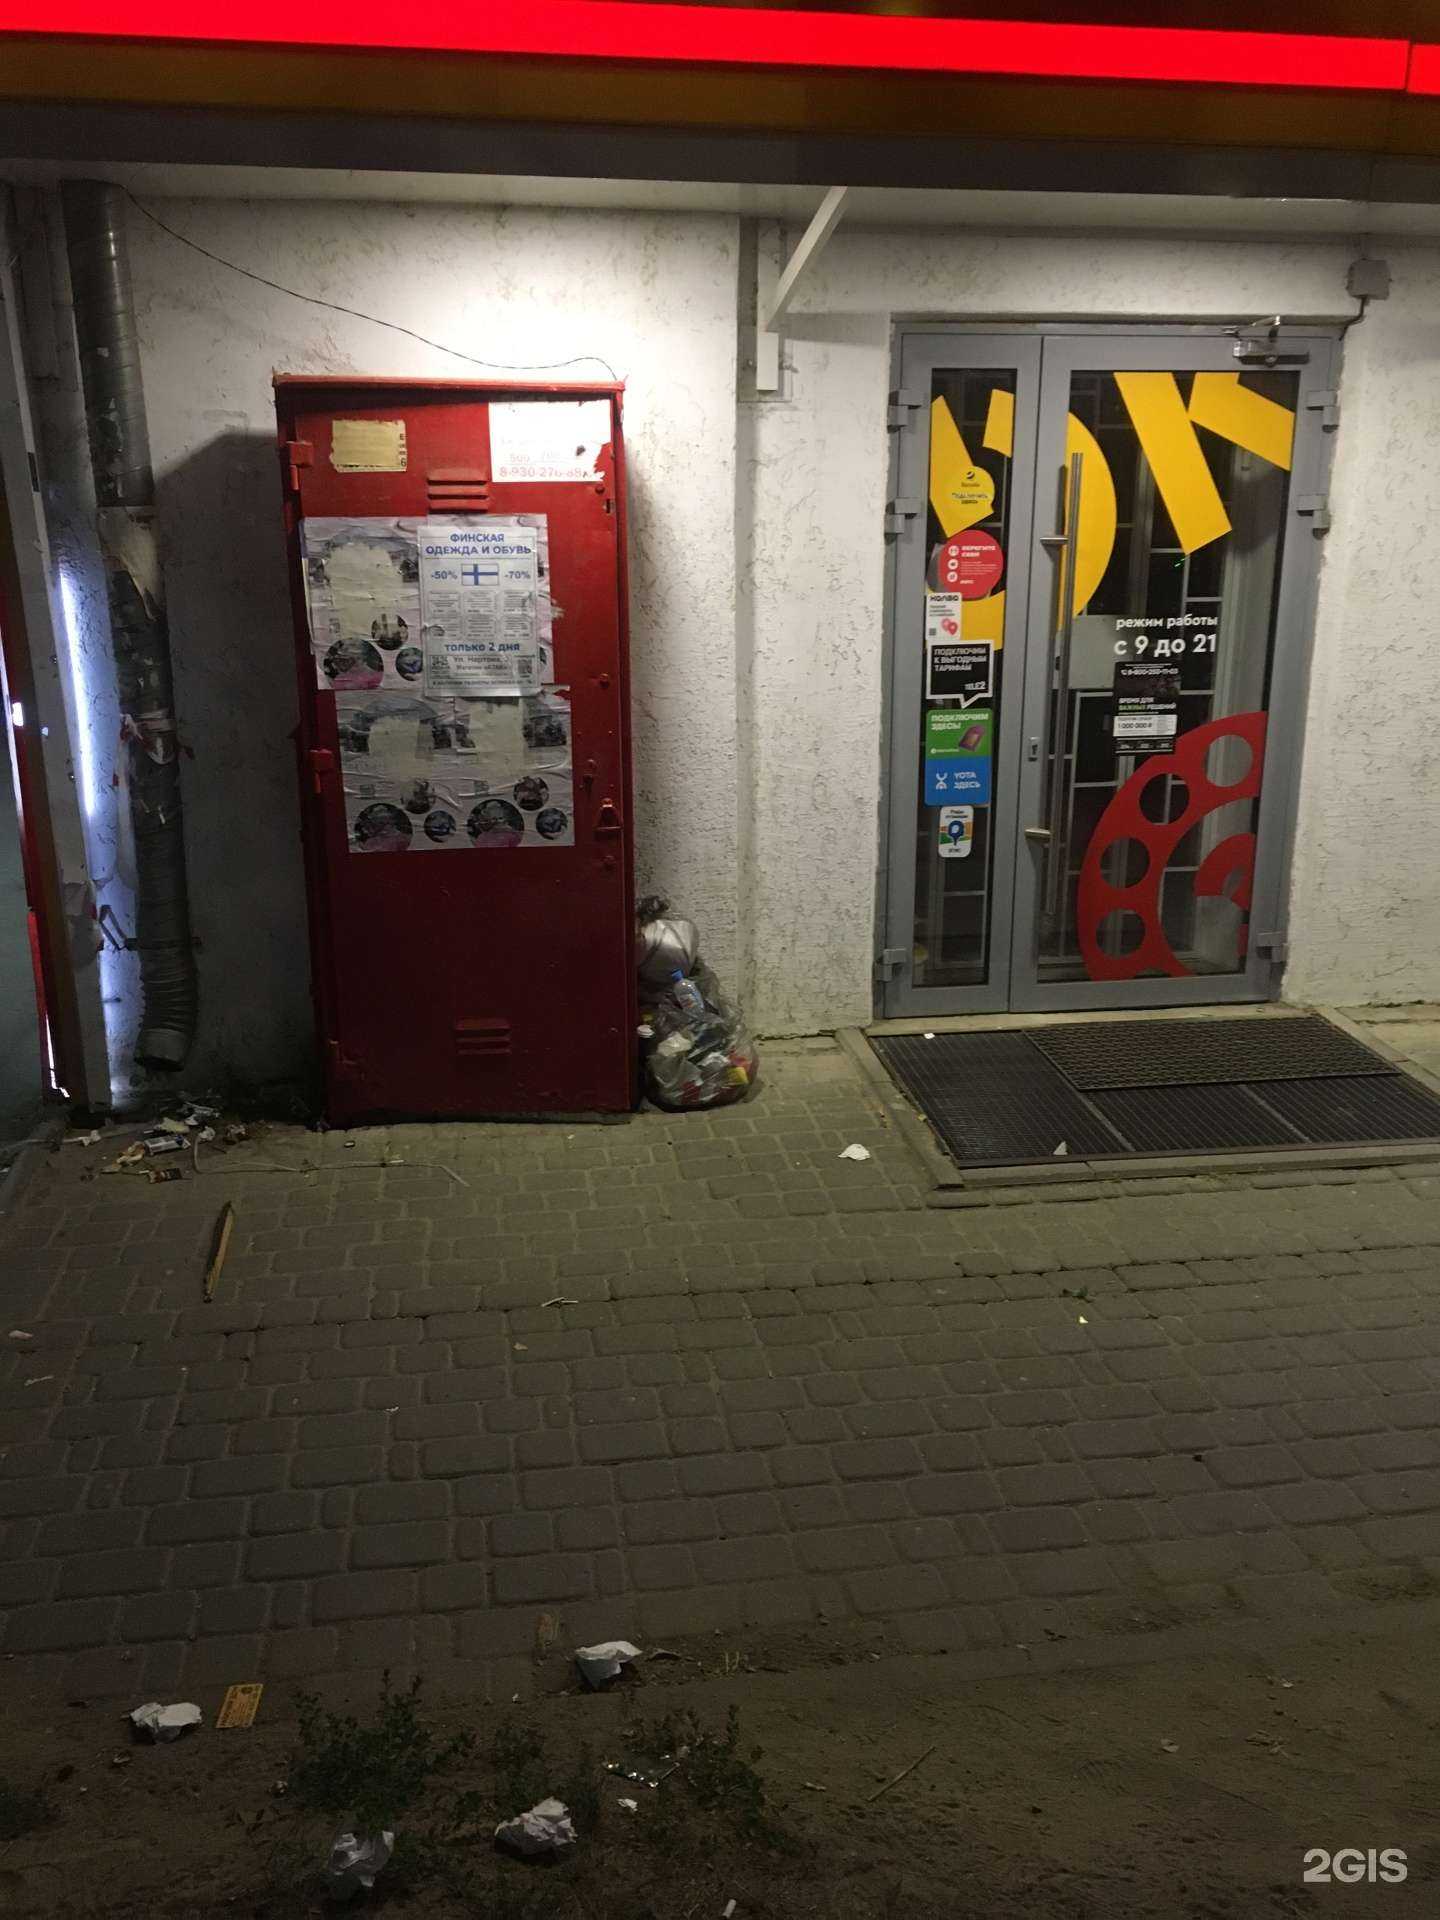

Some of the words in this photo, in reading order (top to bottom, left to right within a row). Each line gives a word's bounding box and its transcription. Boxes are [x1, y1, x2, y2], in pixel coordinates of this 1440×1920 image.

[450, 533, 505, 542] ФИНСКАЯ
[425, 545, 478, 556] ОДЕЖДА
[481, 546, 490, 554] И
[493, 546, 532, 555] ОБУВЬ
[431, 570, 458, 580] -50%
[505, 570, 531, 579] -70%
[1115, 617, 1163, 630] режим
[1166, 613, 1219, 629] работы
[445, 643, 486, 652] только
[488, 642, 496, 652] 2
[498, 642, 520, 652] дня
[1113, 640, 1128, 655] с
[1134, 635, 1149, 654] 9
[1153, 638, 1186, 657] до
[1192, 633, 1217, 653] 21
